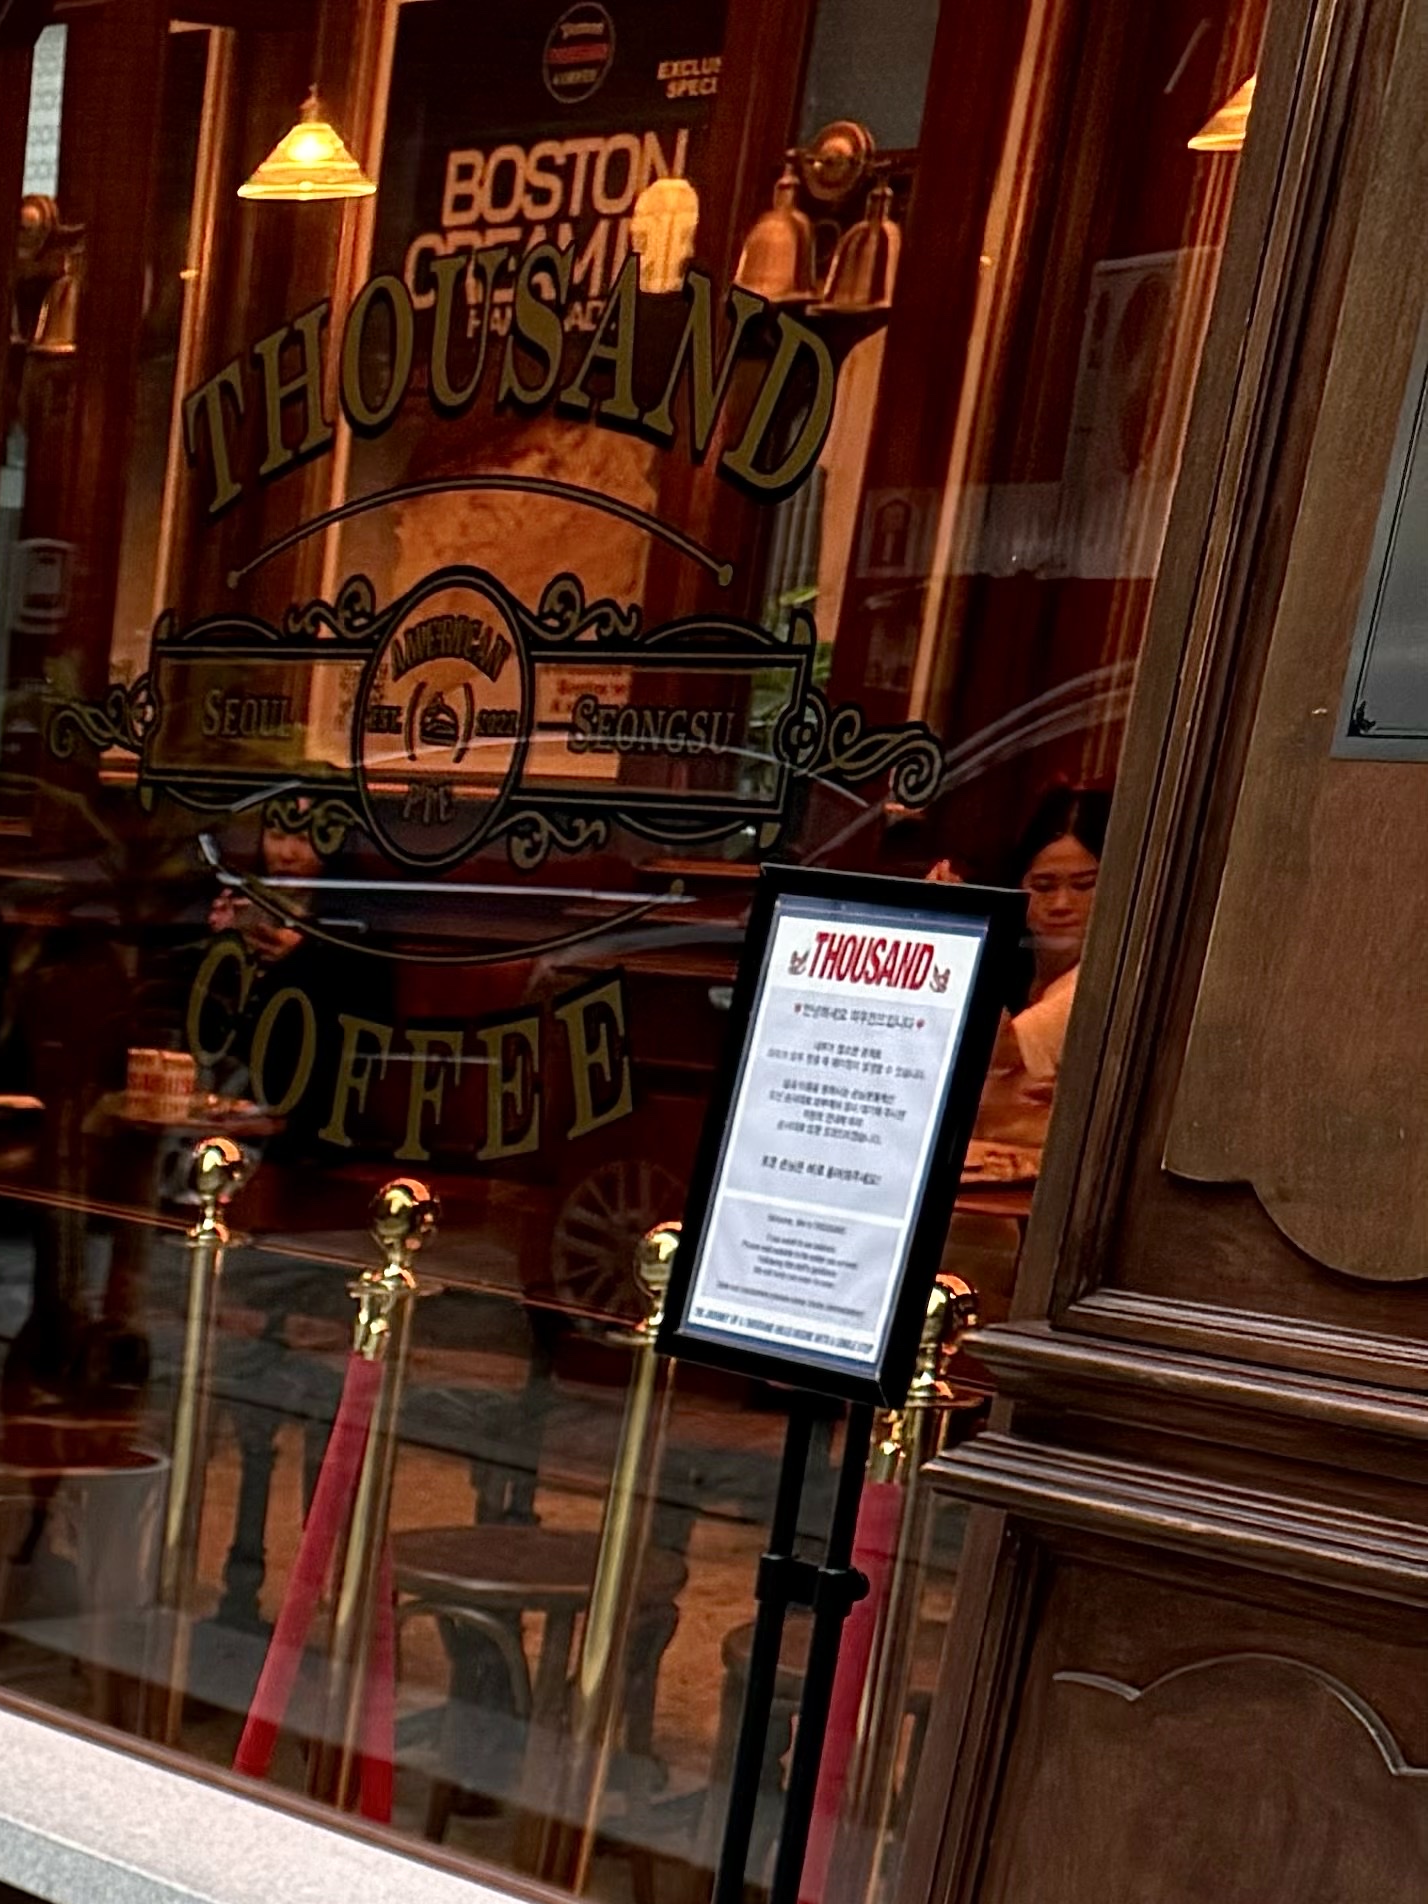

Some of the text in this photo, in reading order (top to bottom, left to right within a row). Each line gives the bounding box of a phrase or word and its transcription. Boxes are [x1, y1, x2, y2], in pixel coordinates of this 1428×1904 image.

[441, 128, 690, 228] BOSTON
[184, 243, 836, 514] THOUSAND
[391, 616, 511, 682] AMERICAN
[200, 688, 294, 738] SEOUL
[569, 698, 735, 755] SEONGSU
[808, 931, 934, 990] THOUSAND
[186, 939, 633, 1162] COFFEE
